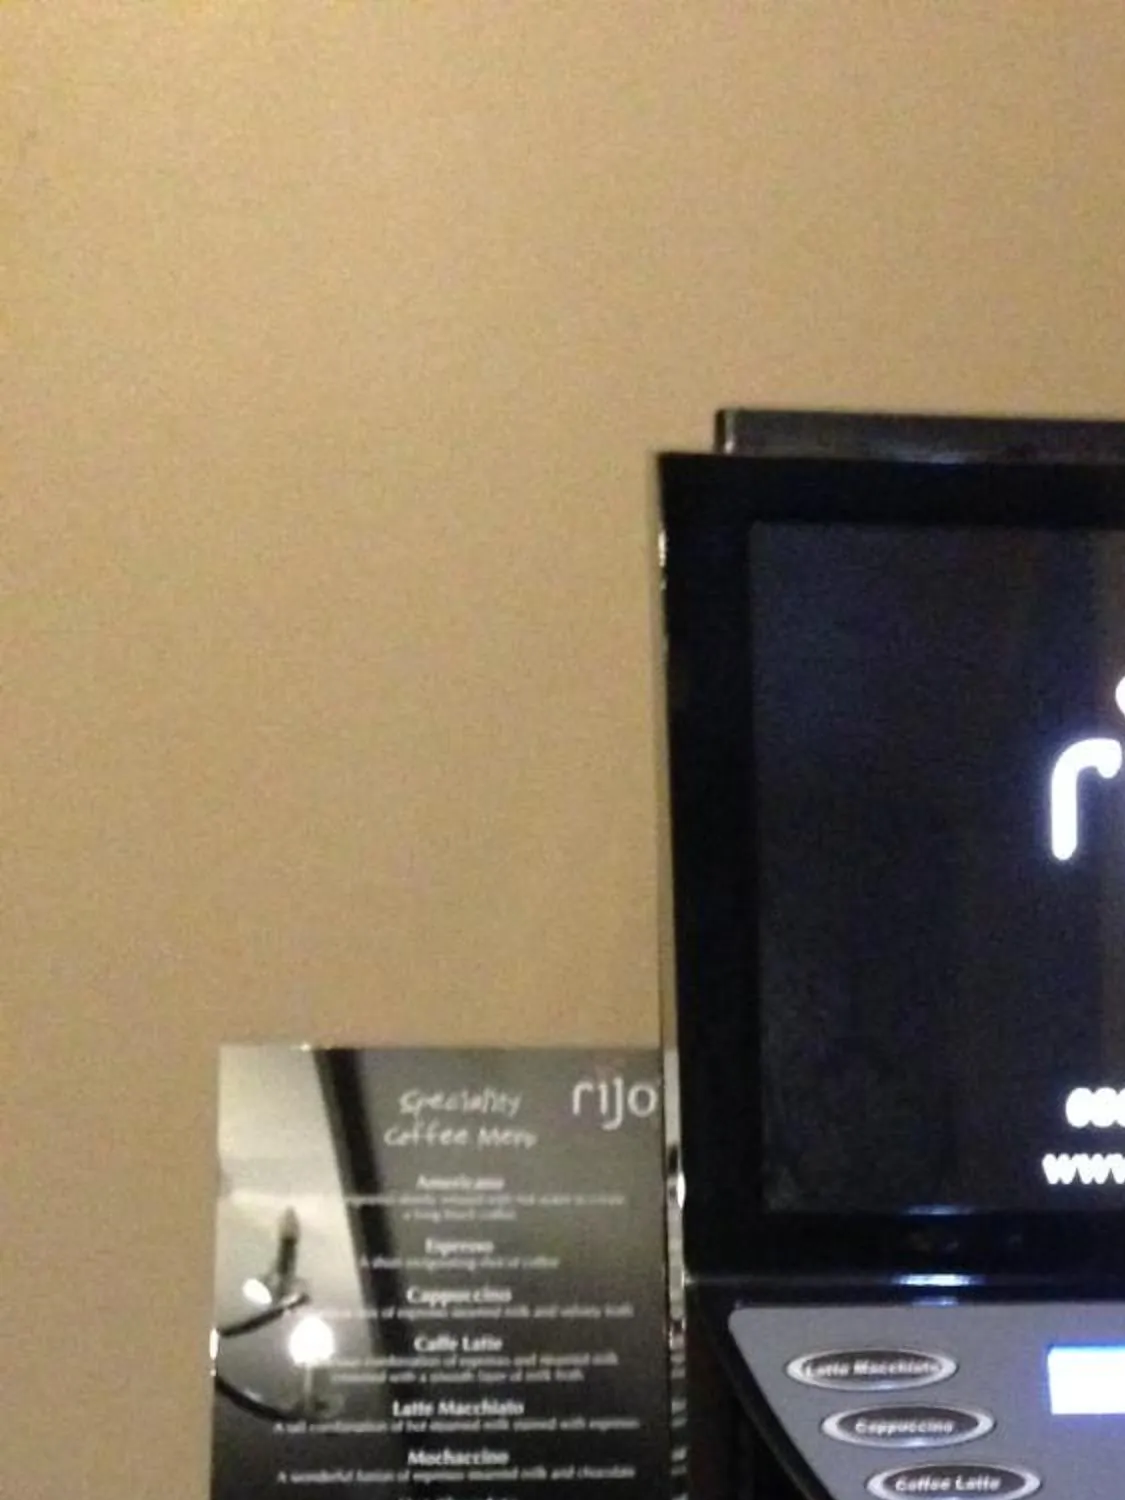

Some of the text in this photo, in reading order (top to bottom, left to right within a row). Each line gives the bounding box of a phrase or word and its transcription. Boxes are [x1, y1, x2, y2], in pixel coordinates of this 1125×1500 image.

[572, 1077, 658, 1131] rijo
[392, 1398, 525, 1417] Latte Macchiato
[407, 1447, 510, 1465] Mochaccino
